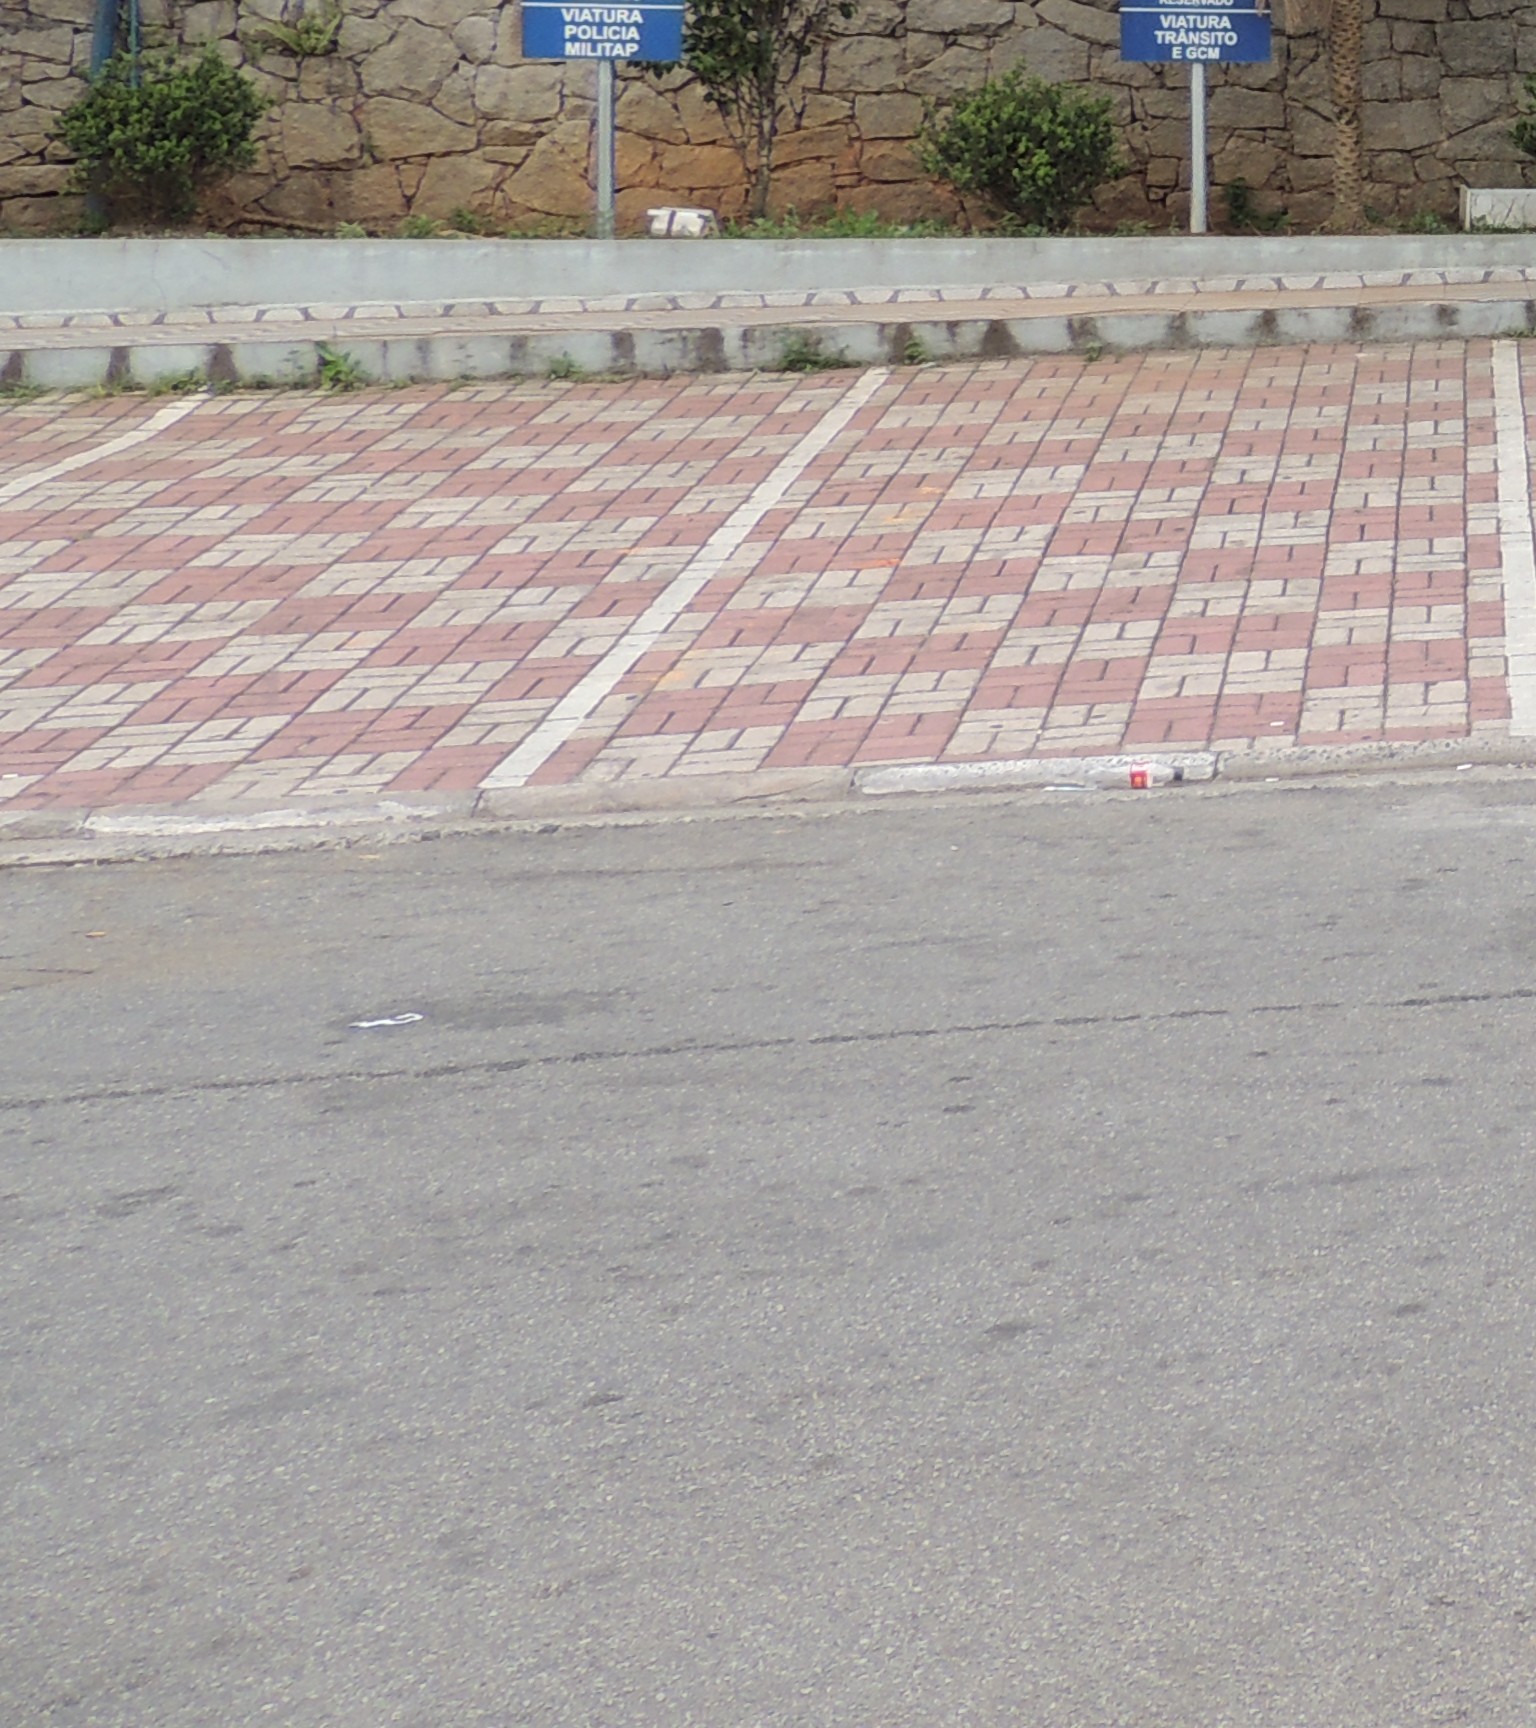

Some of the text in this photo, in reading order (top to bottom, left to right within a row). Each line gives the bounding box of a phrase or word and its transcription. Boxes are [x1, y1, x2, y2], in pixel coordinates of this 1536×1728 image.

[561, 8, 643, 24] VIATURA
[1160, 15, 1231, 29] VIATURA
[564, 25, 640, 40] POLICIA
[1154, 29, 1238, 46] TRÂNSITO
[1172, 47, 1220, 59] E GCM
